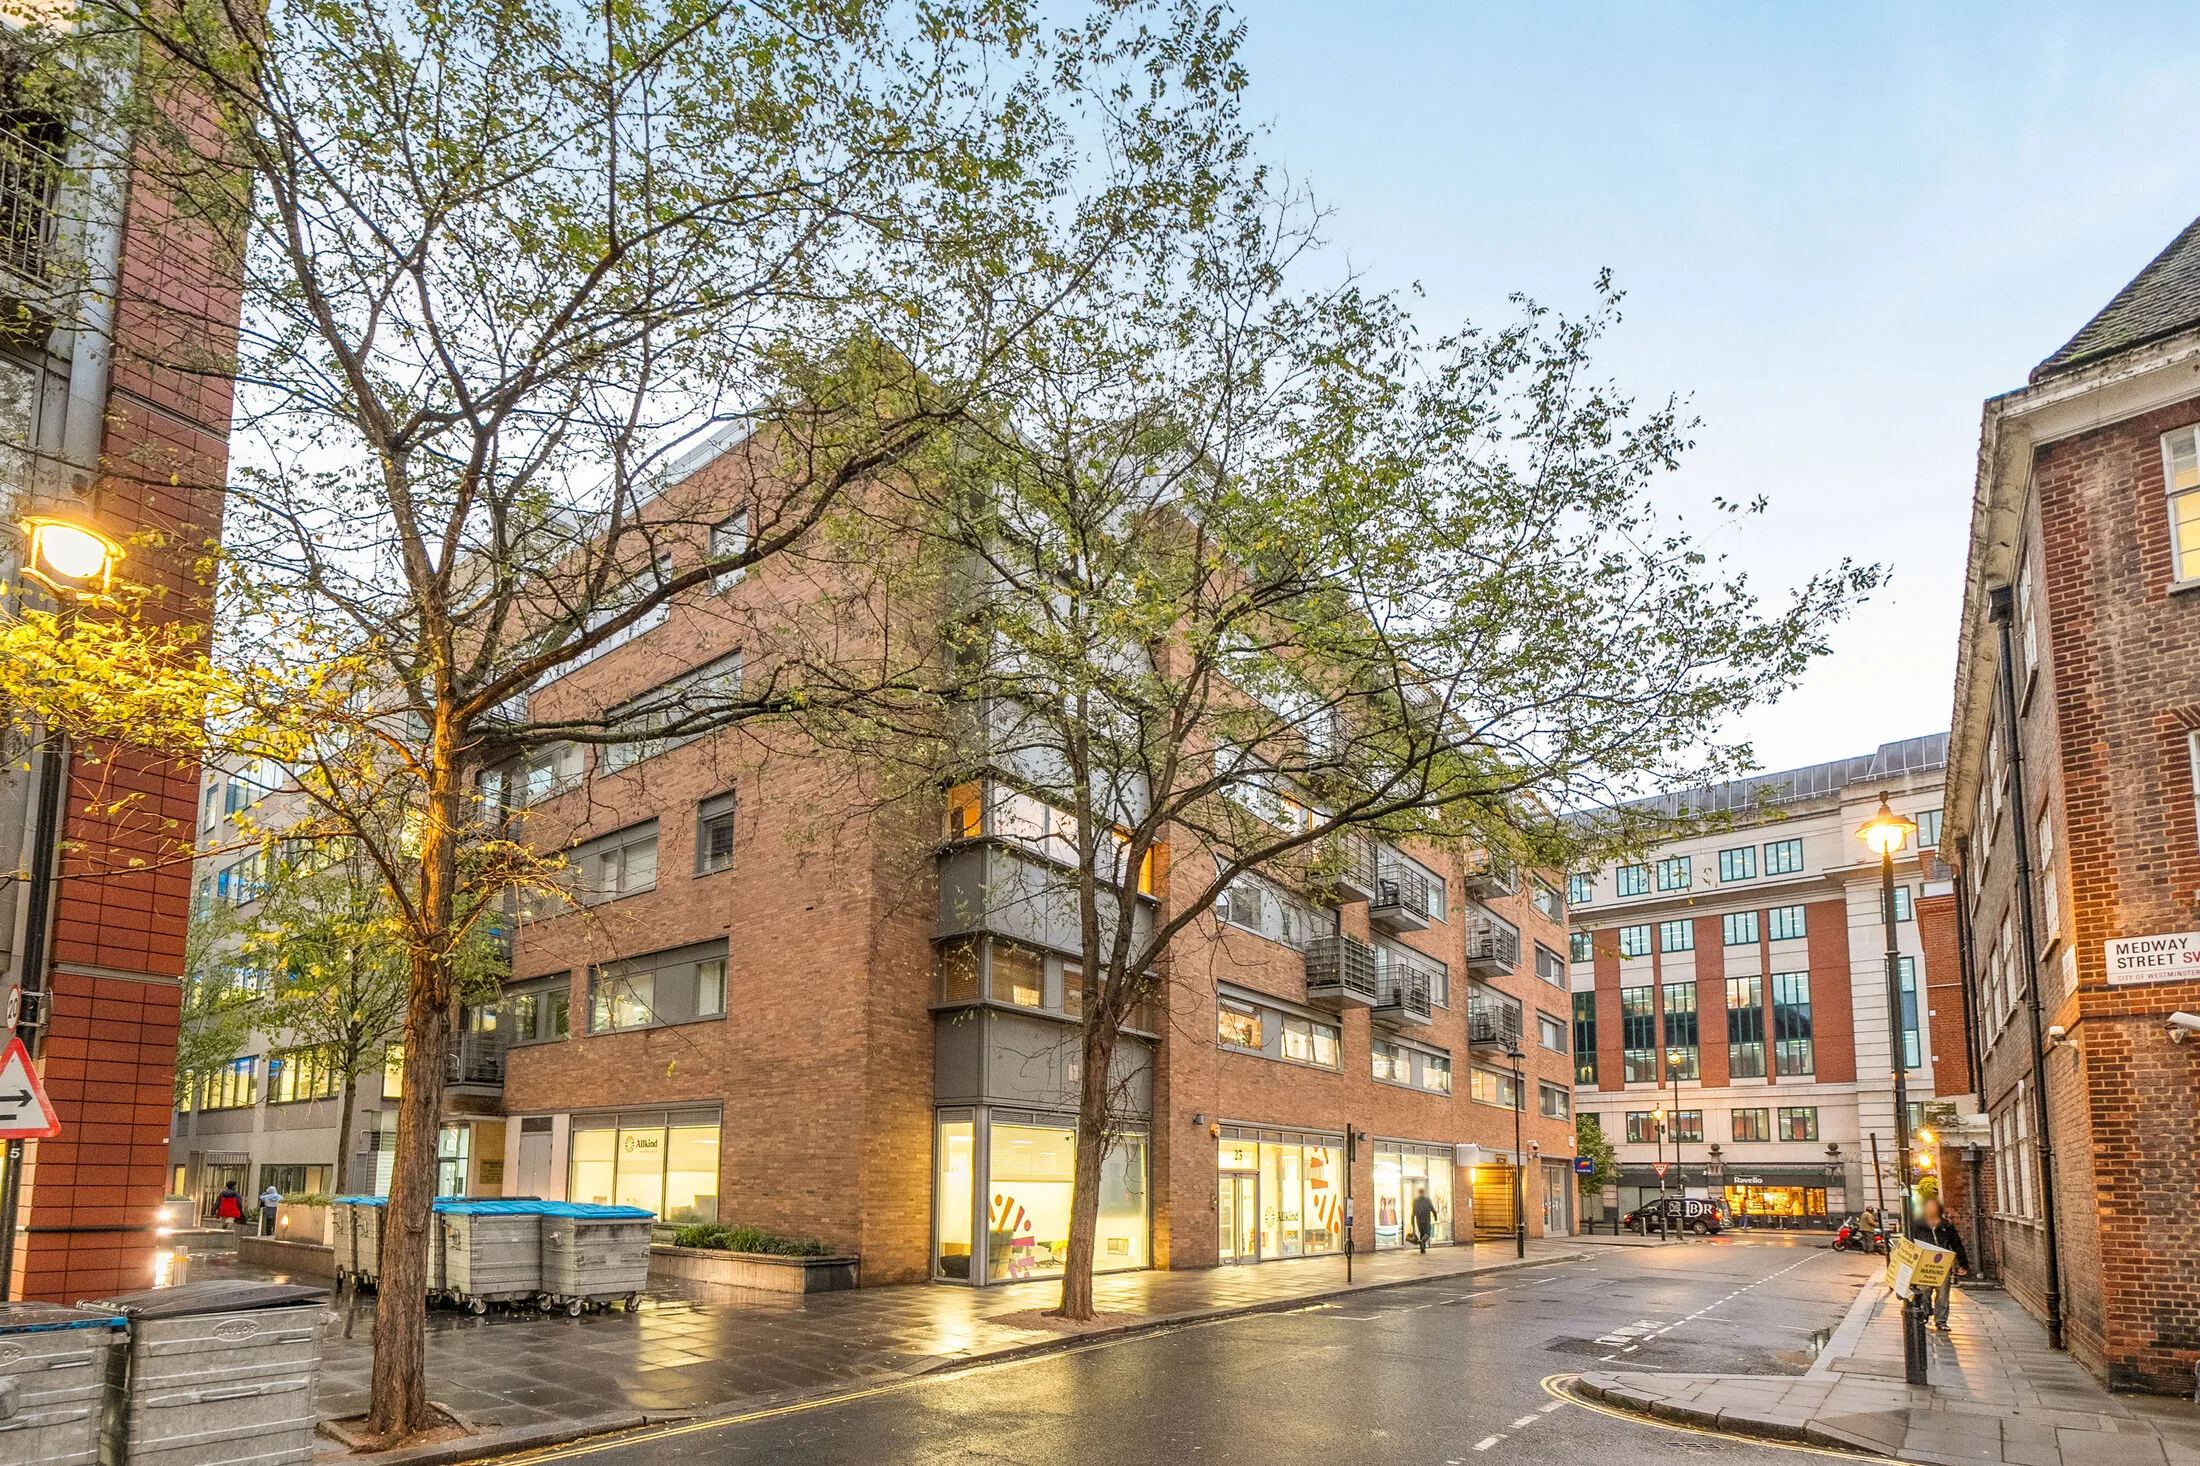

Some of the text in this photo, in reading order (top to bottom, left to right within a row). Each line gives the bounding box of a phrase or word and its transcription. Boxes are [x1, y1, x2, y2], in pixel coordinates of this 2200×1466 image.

[2116, 937, 2188, 955] MEDWAY
[2117, 953, 2176, 969] STREET
[2117, 974, 2133, 982] CITY
[2147, 969, 2200, 979] WESTMINSTER
[8, 997, 18, 1019] 20
[636, 1139, 658, 1148] Allkind
[9, 1147, 21, 1159] 5
[1233, 1149, 1243, 1161] 25
[1277, 1211, 1298, 1221] Allkind
[216, 1325, 257, 1336] TAYLOR
